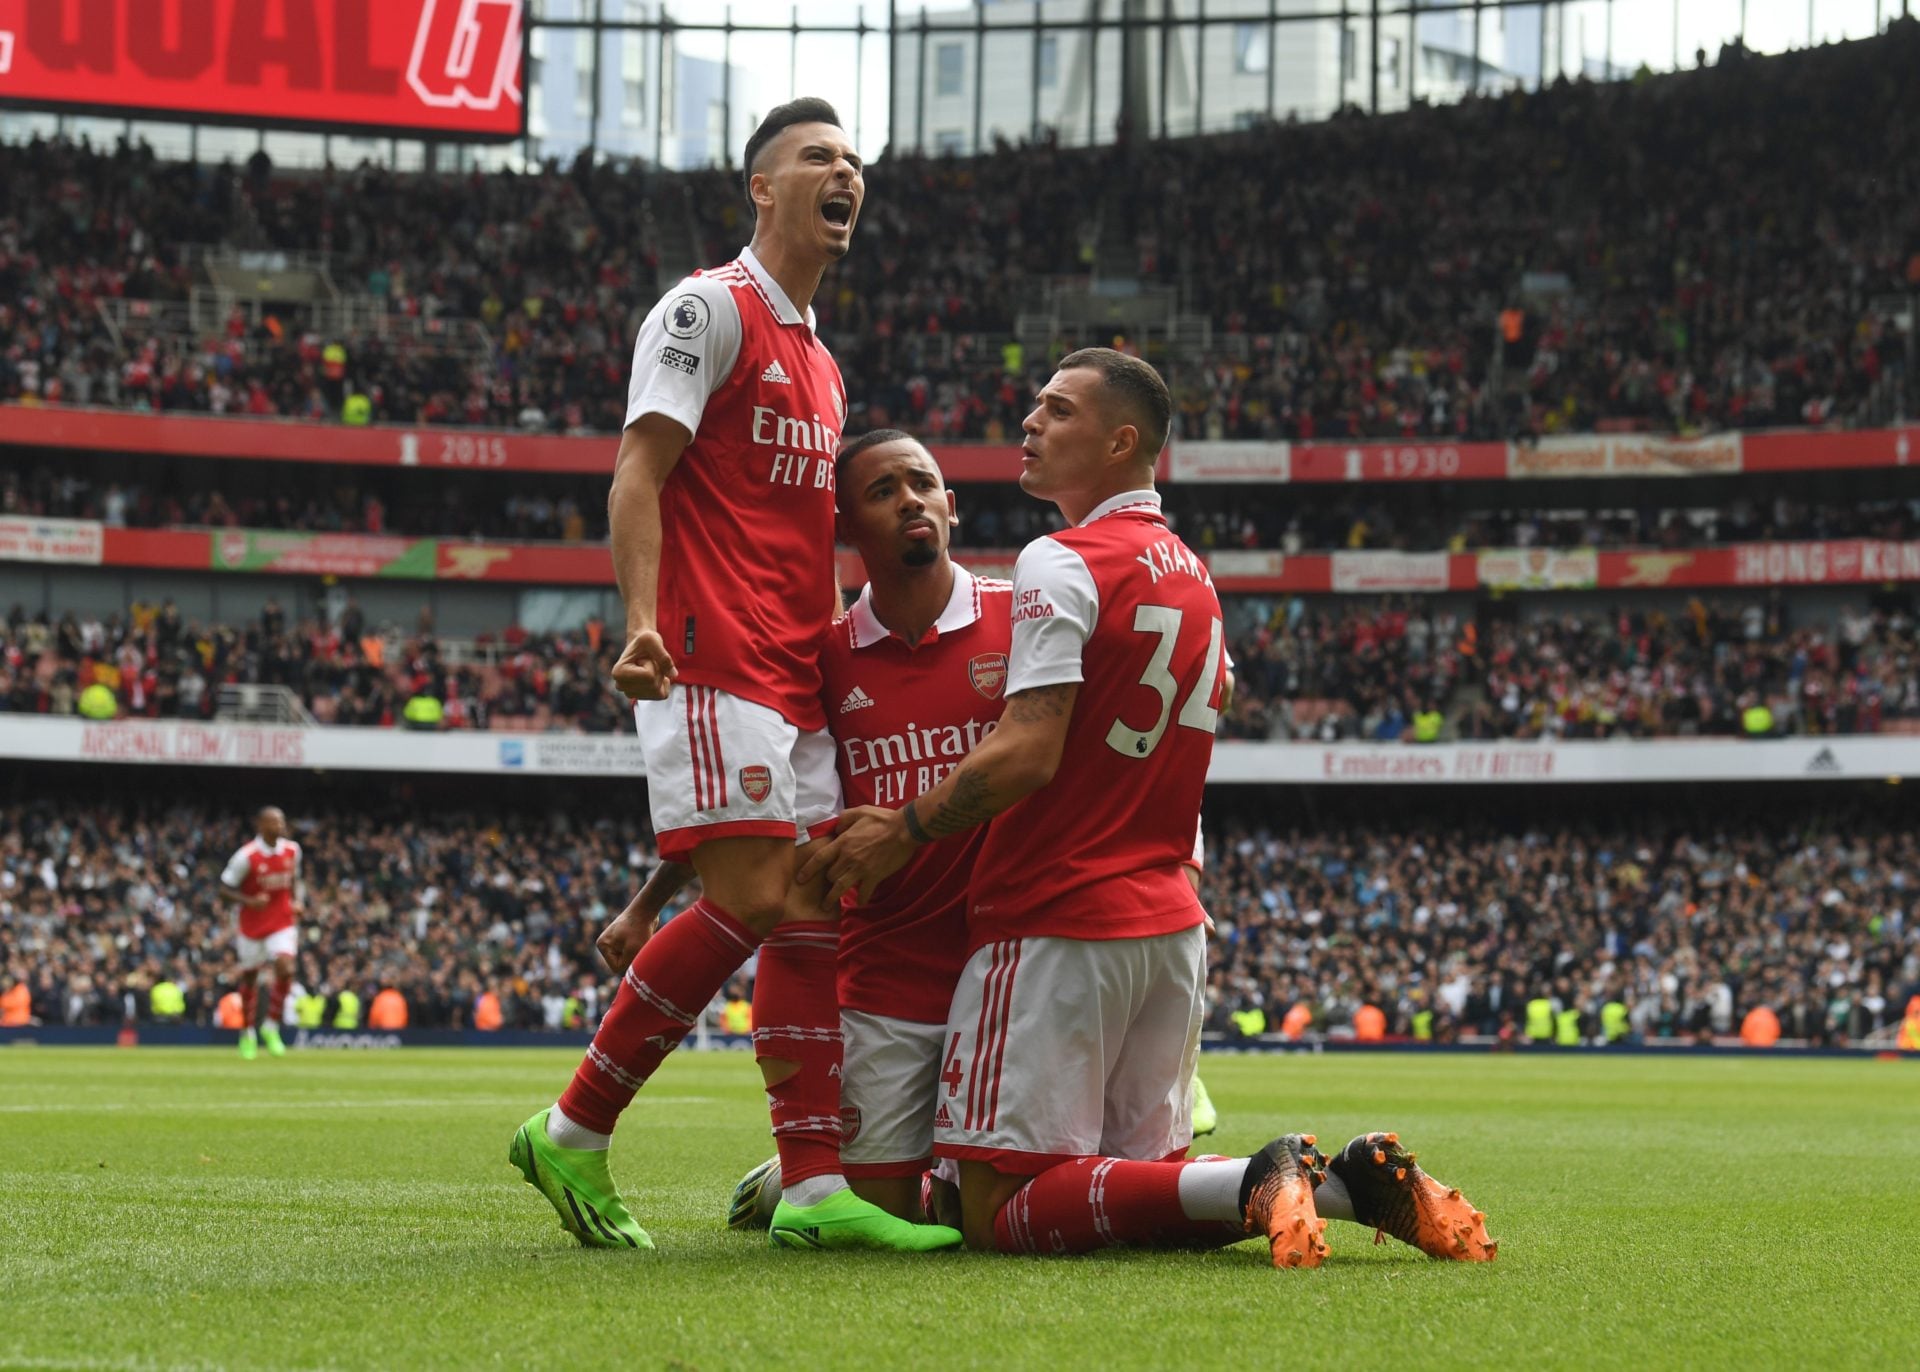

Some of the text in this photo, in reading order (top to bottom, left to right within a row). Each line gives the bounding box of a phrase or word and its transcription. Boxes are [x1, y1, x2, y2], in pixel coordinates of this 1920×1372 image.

[761, 373, 791, 385] adidas
[440, 434, 507, 465] 2015
[1382, 448, 1460, 474] 1930
[769, 453, 836, 493] FLY BE
[973, 660, 1004, 671] Arsenal
[1105, 604, 1223, 759] 34
[840, 698, 875, 714] adidas
[1323, 750, 1445, 776] Emirates
[874, 769, 908, 806] FLY
